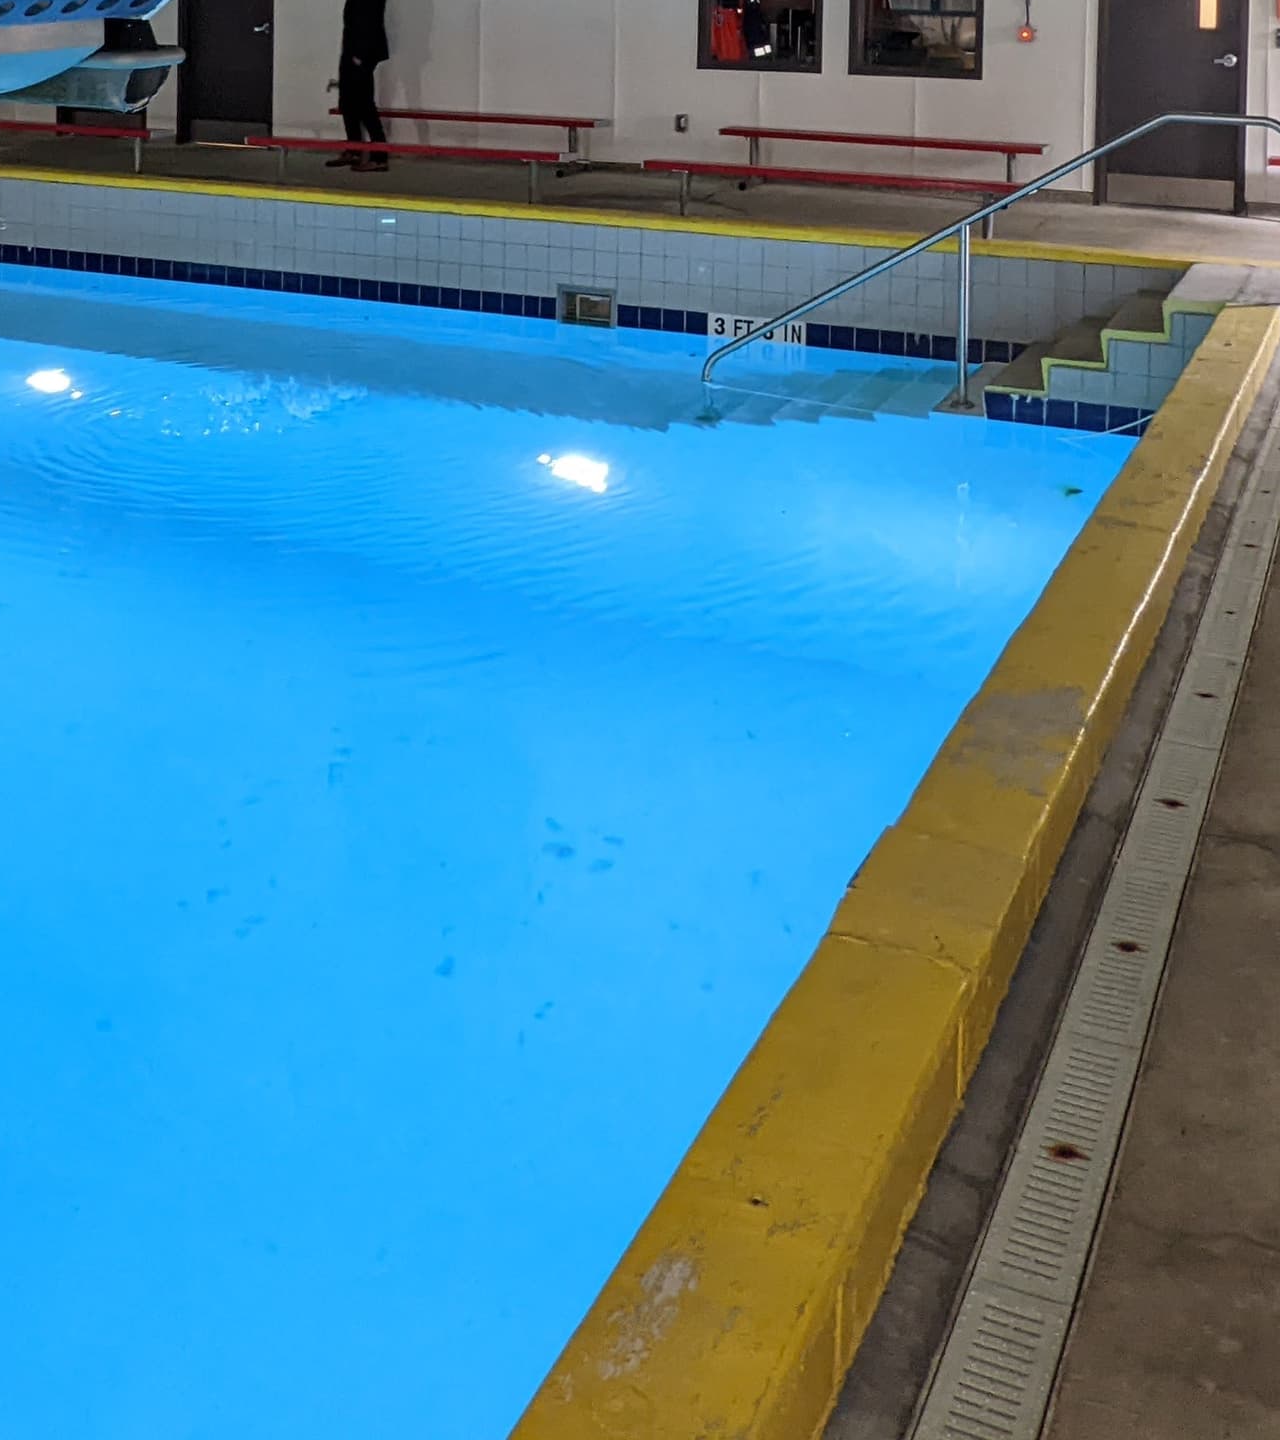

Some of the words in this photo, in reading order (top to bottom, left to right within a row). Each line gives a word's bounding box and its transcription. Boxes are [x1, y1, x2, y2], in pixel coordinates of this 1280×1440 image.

[714, 317, 725, 335] 3
[734, 319, 754, 337] FT
[784, 323, 802, 344] IN
